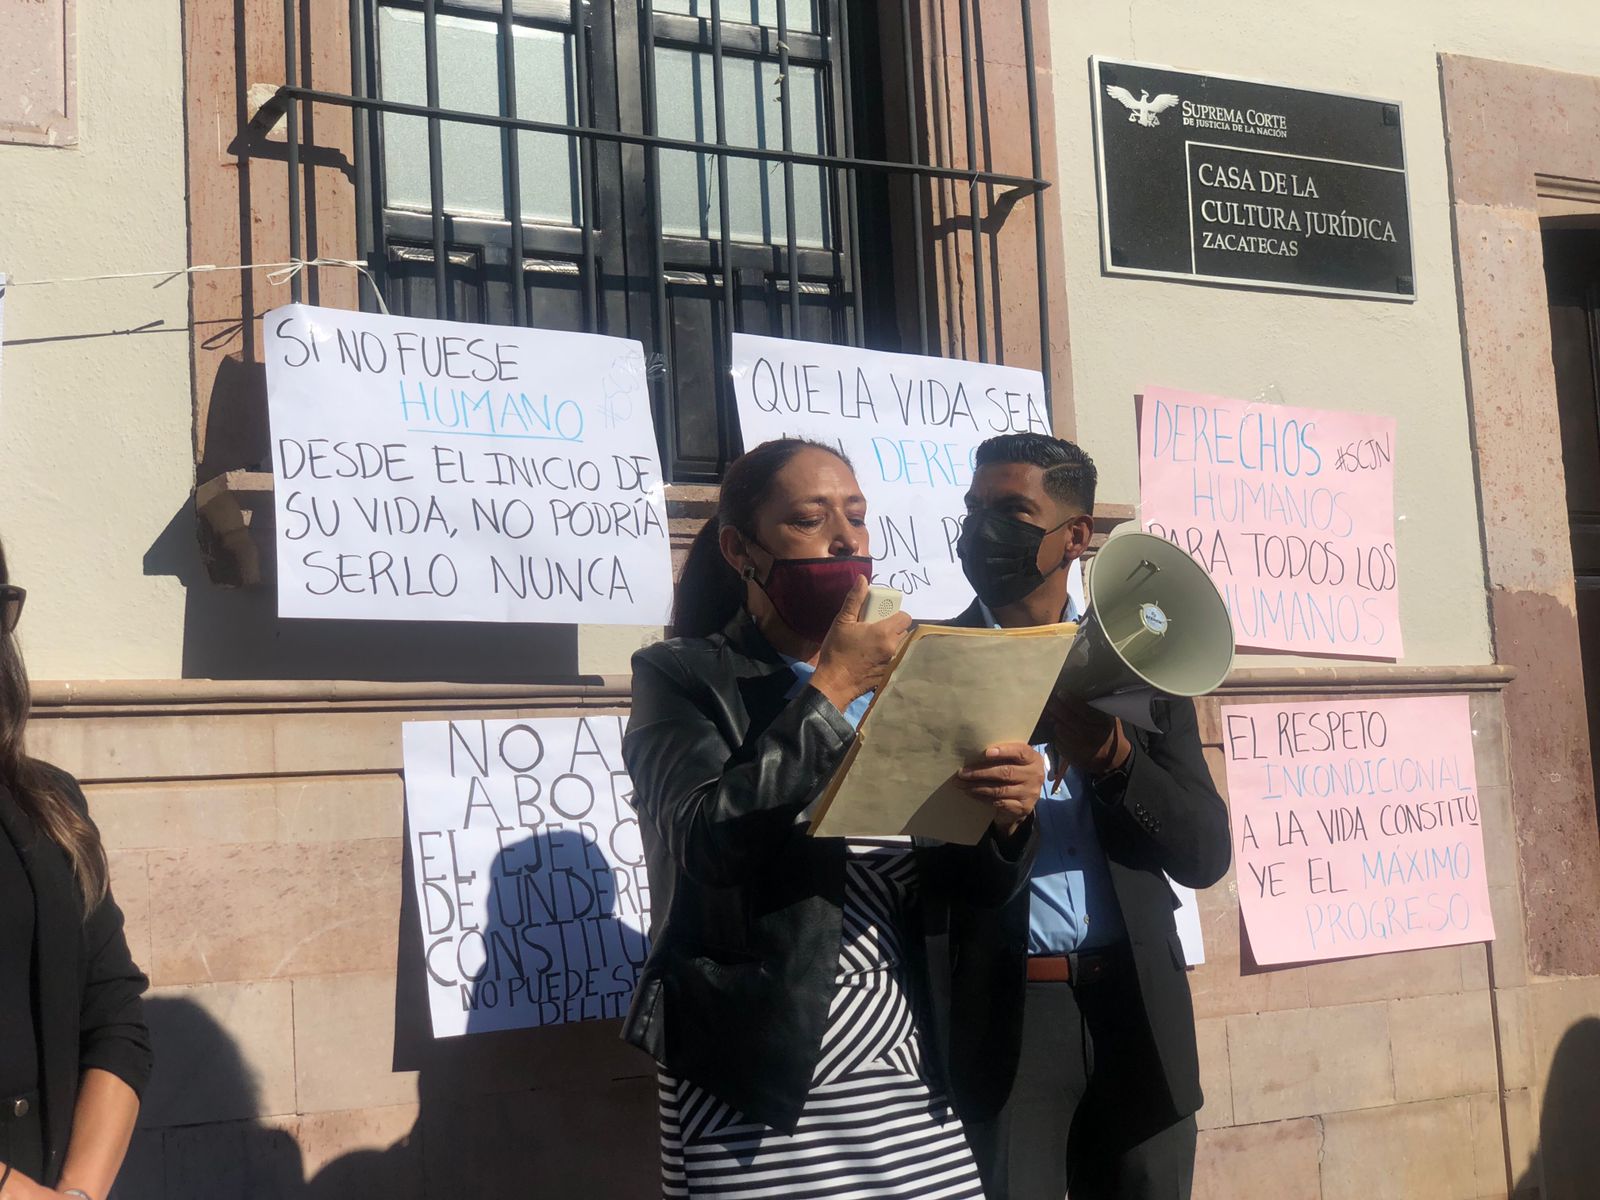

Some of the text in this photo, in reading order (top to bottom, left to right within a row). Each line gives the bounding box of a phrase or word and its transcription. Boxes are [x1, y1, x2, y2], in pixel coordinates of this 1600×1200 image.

[1182, 100, 1287, 129] SUPREMA CORTE
[1183, 118, 1287, 138] DE JUSTICIA DE LA NACIÓN
[1198, 163, 1319, 199] CASA DE LA
[1201, 199, 1397, 243] CULTURA JURÍDICA
[1202, 232, 1299, 256] ZACATECAS
[276, 317, 519, 381] SI NO FUESE
[400, 380, 584, 440] HUMANO
[752, 357, 1053, 437] QUE LA VIDA SEA
[1153, 399, 1322, 477] DERECHOS
[1335, 431, 1391, 472] #SCJN
[278, 438, 653, 496] DESDE EL INICIO DE
[284, 491, 665, 540] SU VIDA, NO PODRÍA
[1193, 467, 1353, 538] HUMANOS
[302, 550, 634, 604] SERLO NUNCA
[1240, 532, 1345, 586] TODOS
[1356, 543, 1396, 591] LOS
[449, 719, 545, 778] NO
[1227, 710, 1388, 761] EL RESPETO
[1261, 755, 1471, 800] INCONDICIONAL
[1241, 795, 1479, 852] A LA VIDA CONSTITU
[418, 829, 477, 882] EL
[1248, 842, 1471, 899] YE EL MÁXIMO
[422, 877, 480, 935] DE
[1304, 892, 1470, 951] PROGRESO
[460, 979, 498, 1011] NO
[508, 967, 601, 1008] PUEDE
